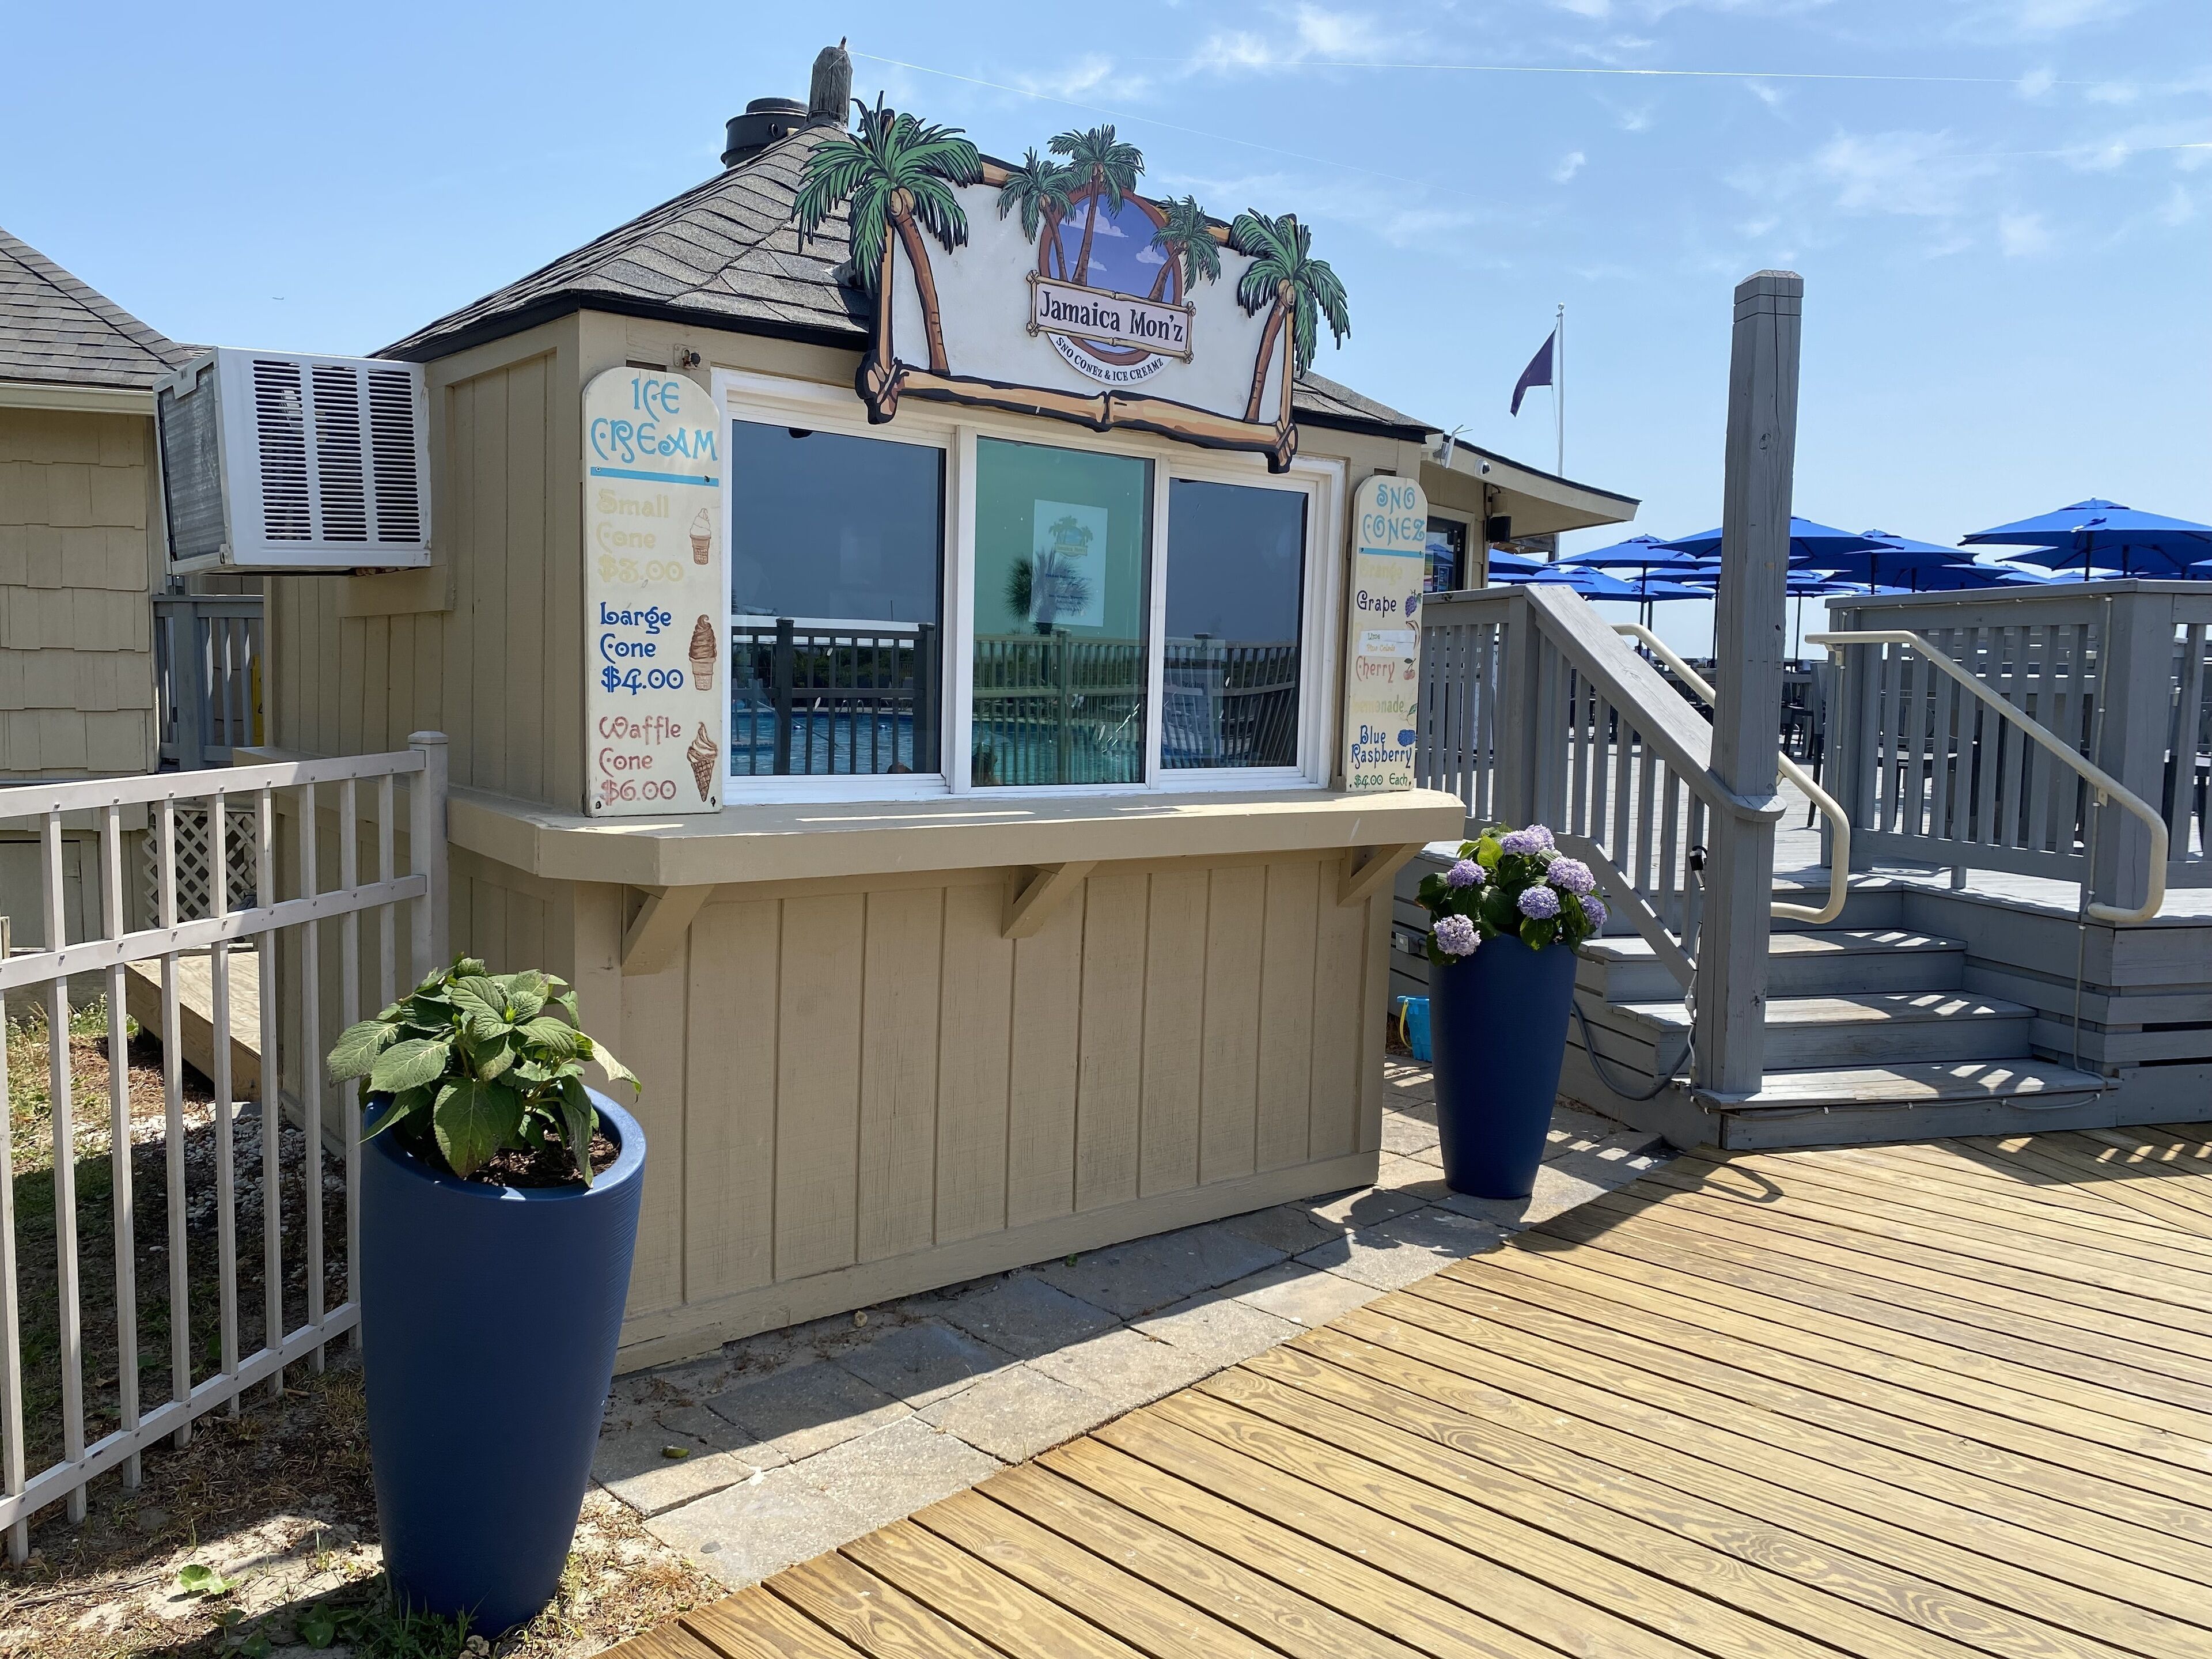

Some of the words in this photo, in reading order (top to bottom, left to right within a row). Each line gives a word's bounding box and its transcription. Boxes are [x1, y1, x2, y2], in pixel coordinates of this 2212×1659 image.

[1040, 290, 1121, 332] Jamaica
[1128, 308, 1183, 343] Mon'z
[1055, 336, 1074, 358] SNO
[1074, 355, 1103, 378] CONEZ
[1104, 371, 1111, 381] &
[1112, 370, 1129, 381] ICE
[1130, 357, 1164, 380] CREAMZ
[631, 377, 680, 423] ICE
[590, 417, 718, 464] CREAM
[596, 488, 670, 518] Small
[1376, 483, 1415, 515] SNO
[596, 522, 657, 554] Cone
[1362, 514, 1426, 546] CONEZ
[600, 601, 672, 634] Large
[1357, 590, 1397, 618] Grape
[600, 632, 657, 664] Cone
[600, 665, 684, 696] $4.00
[1355, 655, 1395, 684] Cherry
[599, 715, 682, 745] Waffle
[1359, 724, 1387, 745] Blue
[599, 747, 654, 778] Cone
[1351, 743, 1412, 770] Raspberry
[599, 779, 677, 806] $6.00
[1389, 772, 1408, 786] Each
